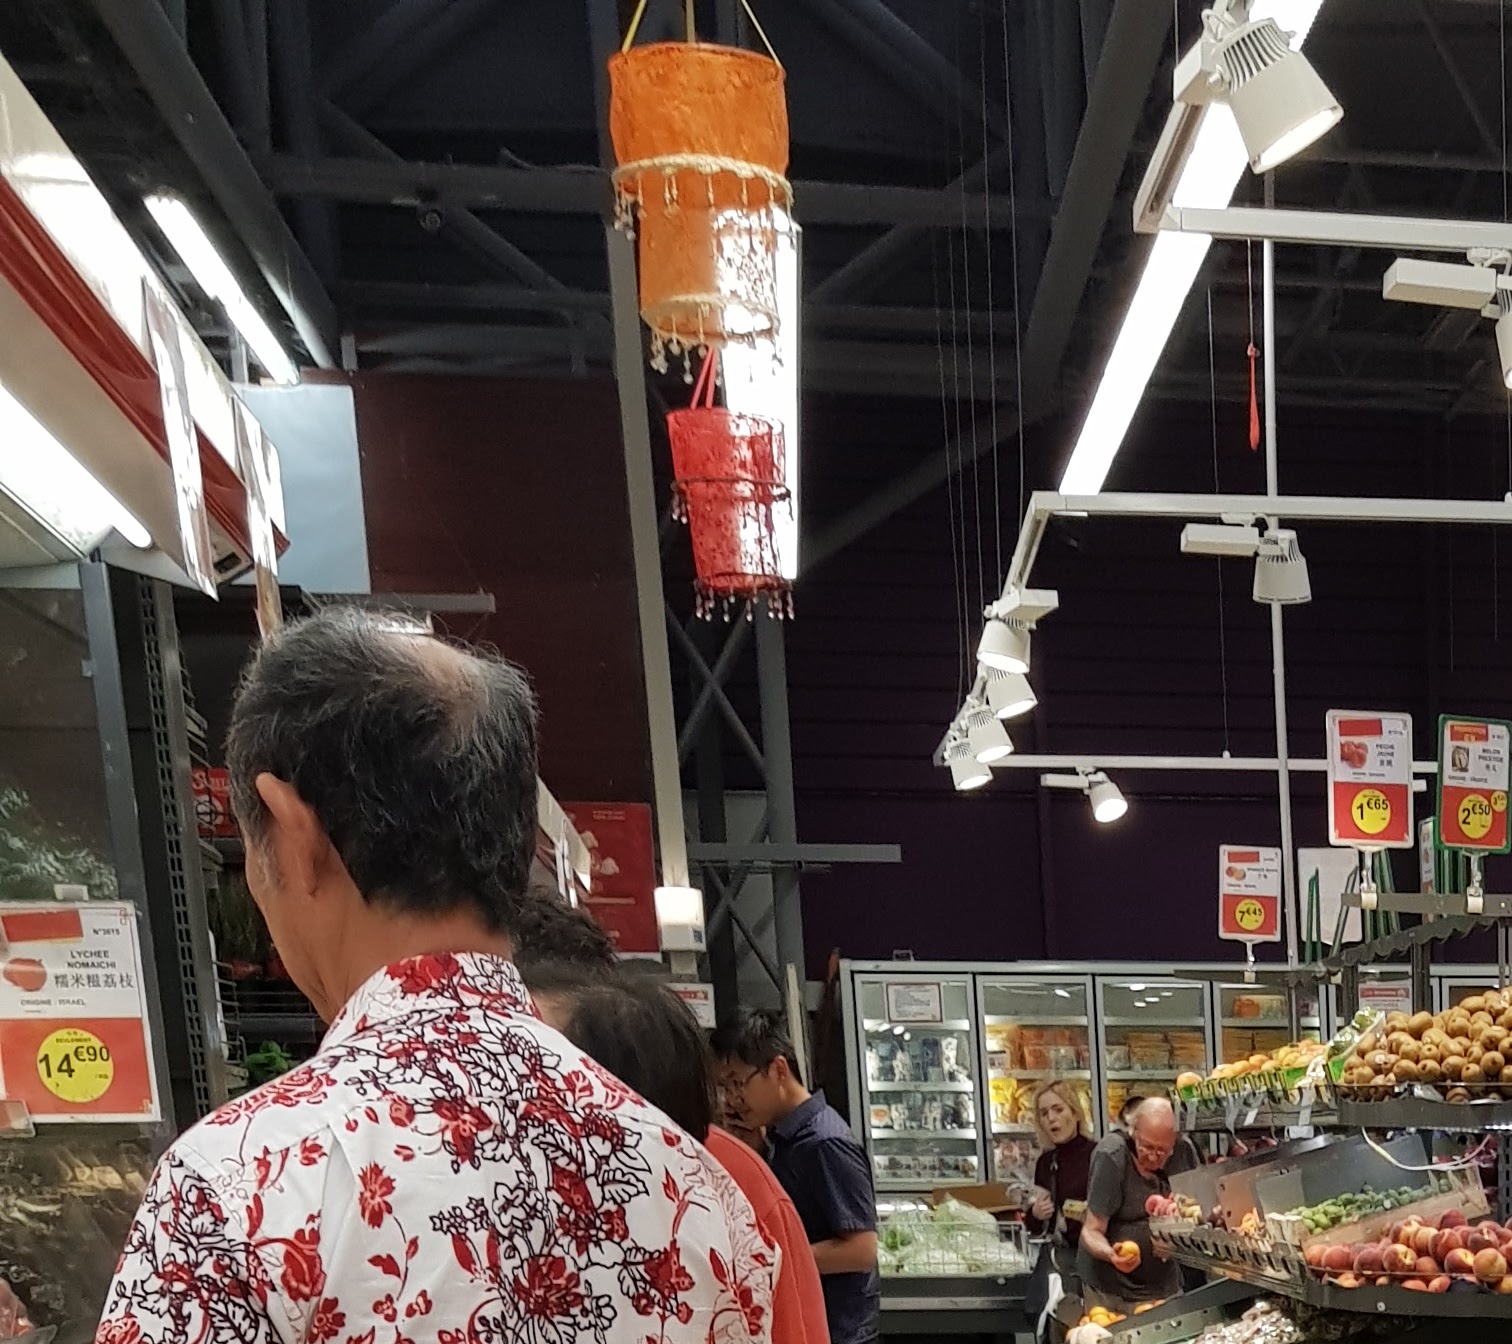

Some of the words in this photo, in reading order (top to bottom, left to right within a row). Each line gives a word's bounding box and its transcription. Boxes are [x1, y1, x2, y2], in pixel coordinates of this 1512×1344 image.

[70, 950, 110, 959] LYCHEE
[67, 961, 116, 970] NOMAICHI
[39, 1046, 110, 1079] 14€90
